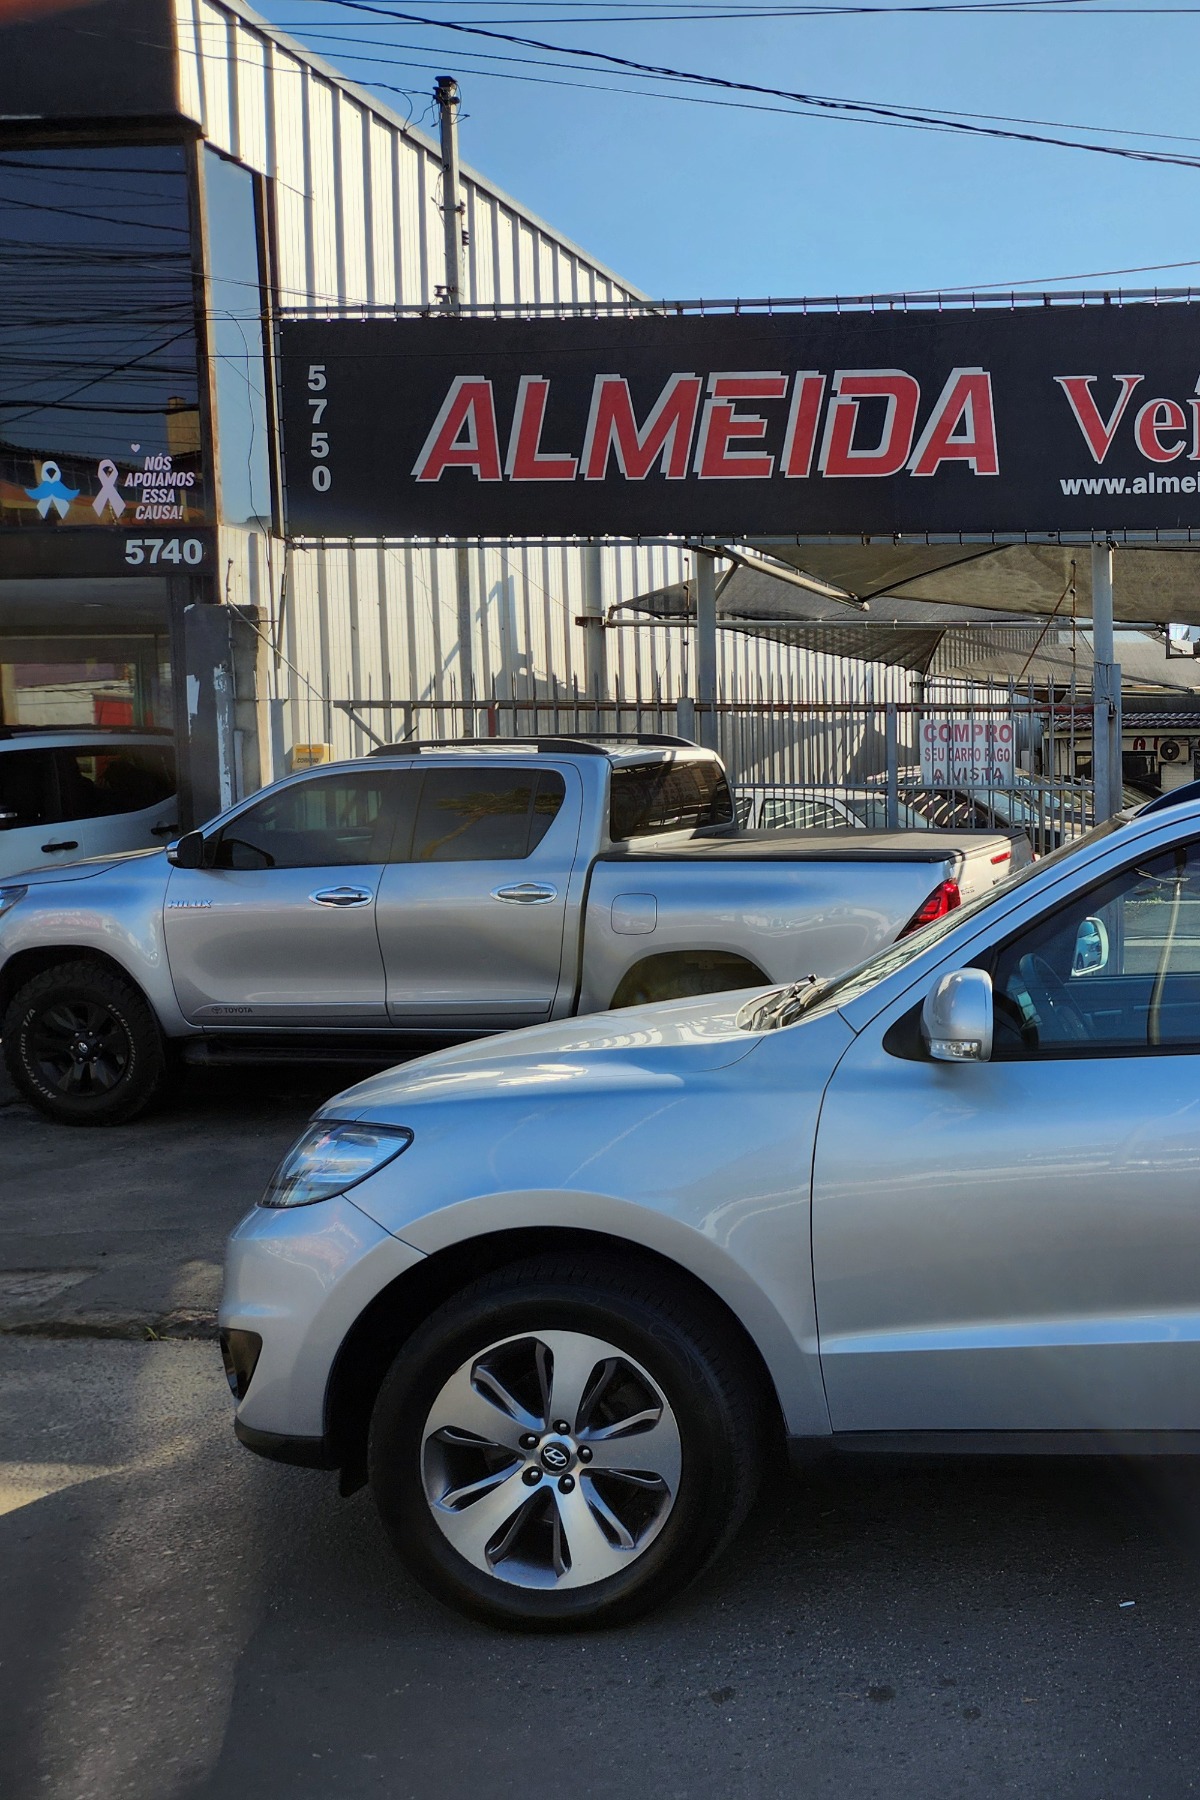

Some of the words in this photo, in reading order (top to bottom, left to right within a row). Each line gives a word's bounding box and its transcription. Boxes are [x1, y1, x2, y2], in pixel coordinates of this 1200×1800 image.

[411, 366, 1000, 482] ALMEIDA
[144, 453, 172, 471] NÓS
[124, 472, 195, 487] APOIAMOS
[142, 489, 175, 503] ESSA
[135, 505, 184, 520] CAUSA!
[125, 539, 203, 565] 5740
[924, 724, 1013, 743] COMPRO
